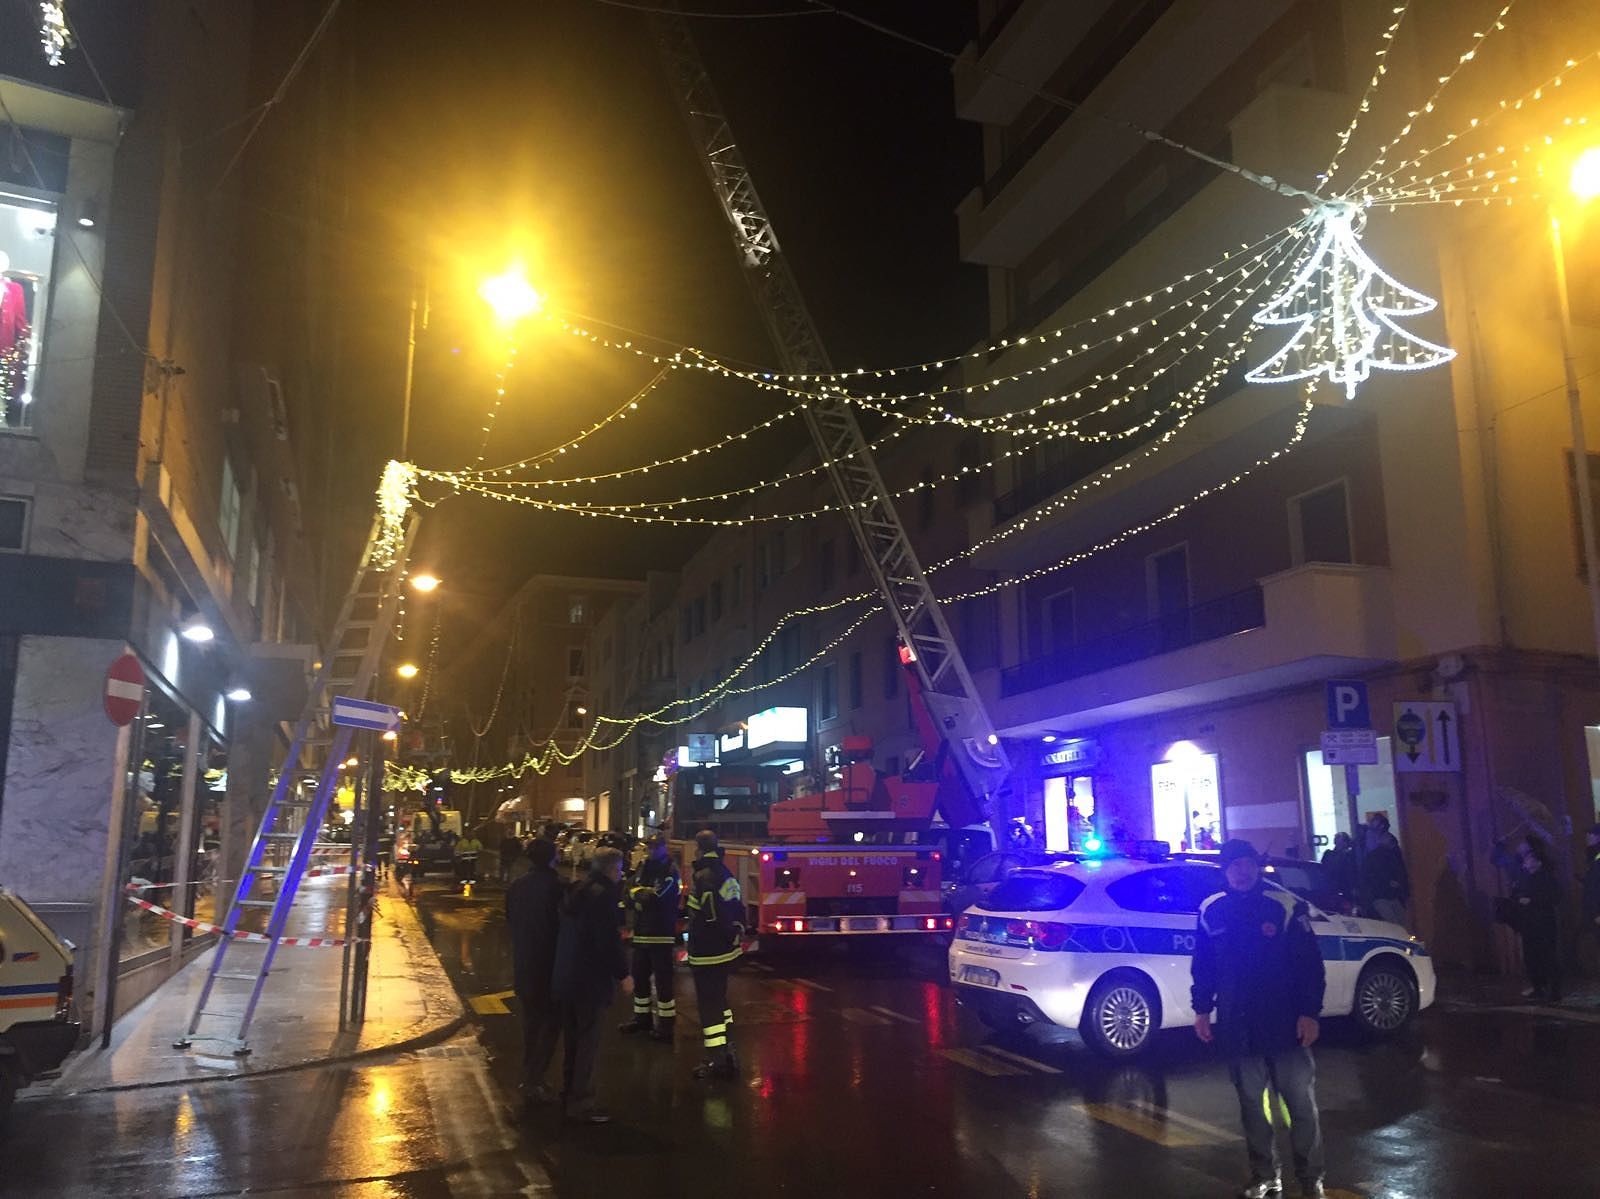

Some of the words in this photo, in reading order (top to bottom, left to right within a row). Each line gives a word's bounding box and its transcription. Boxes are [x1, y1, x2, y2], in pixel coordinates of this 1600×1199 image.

[1335, 686, 1360, 723] P
[808, 856, 838, 866] VIGILI
[840, 856, 860, 866] DEL
[863, 856, 898, 866] FUOCO
[847, 883, 863, 893] 115
